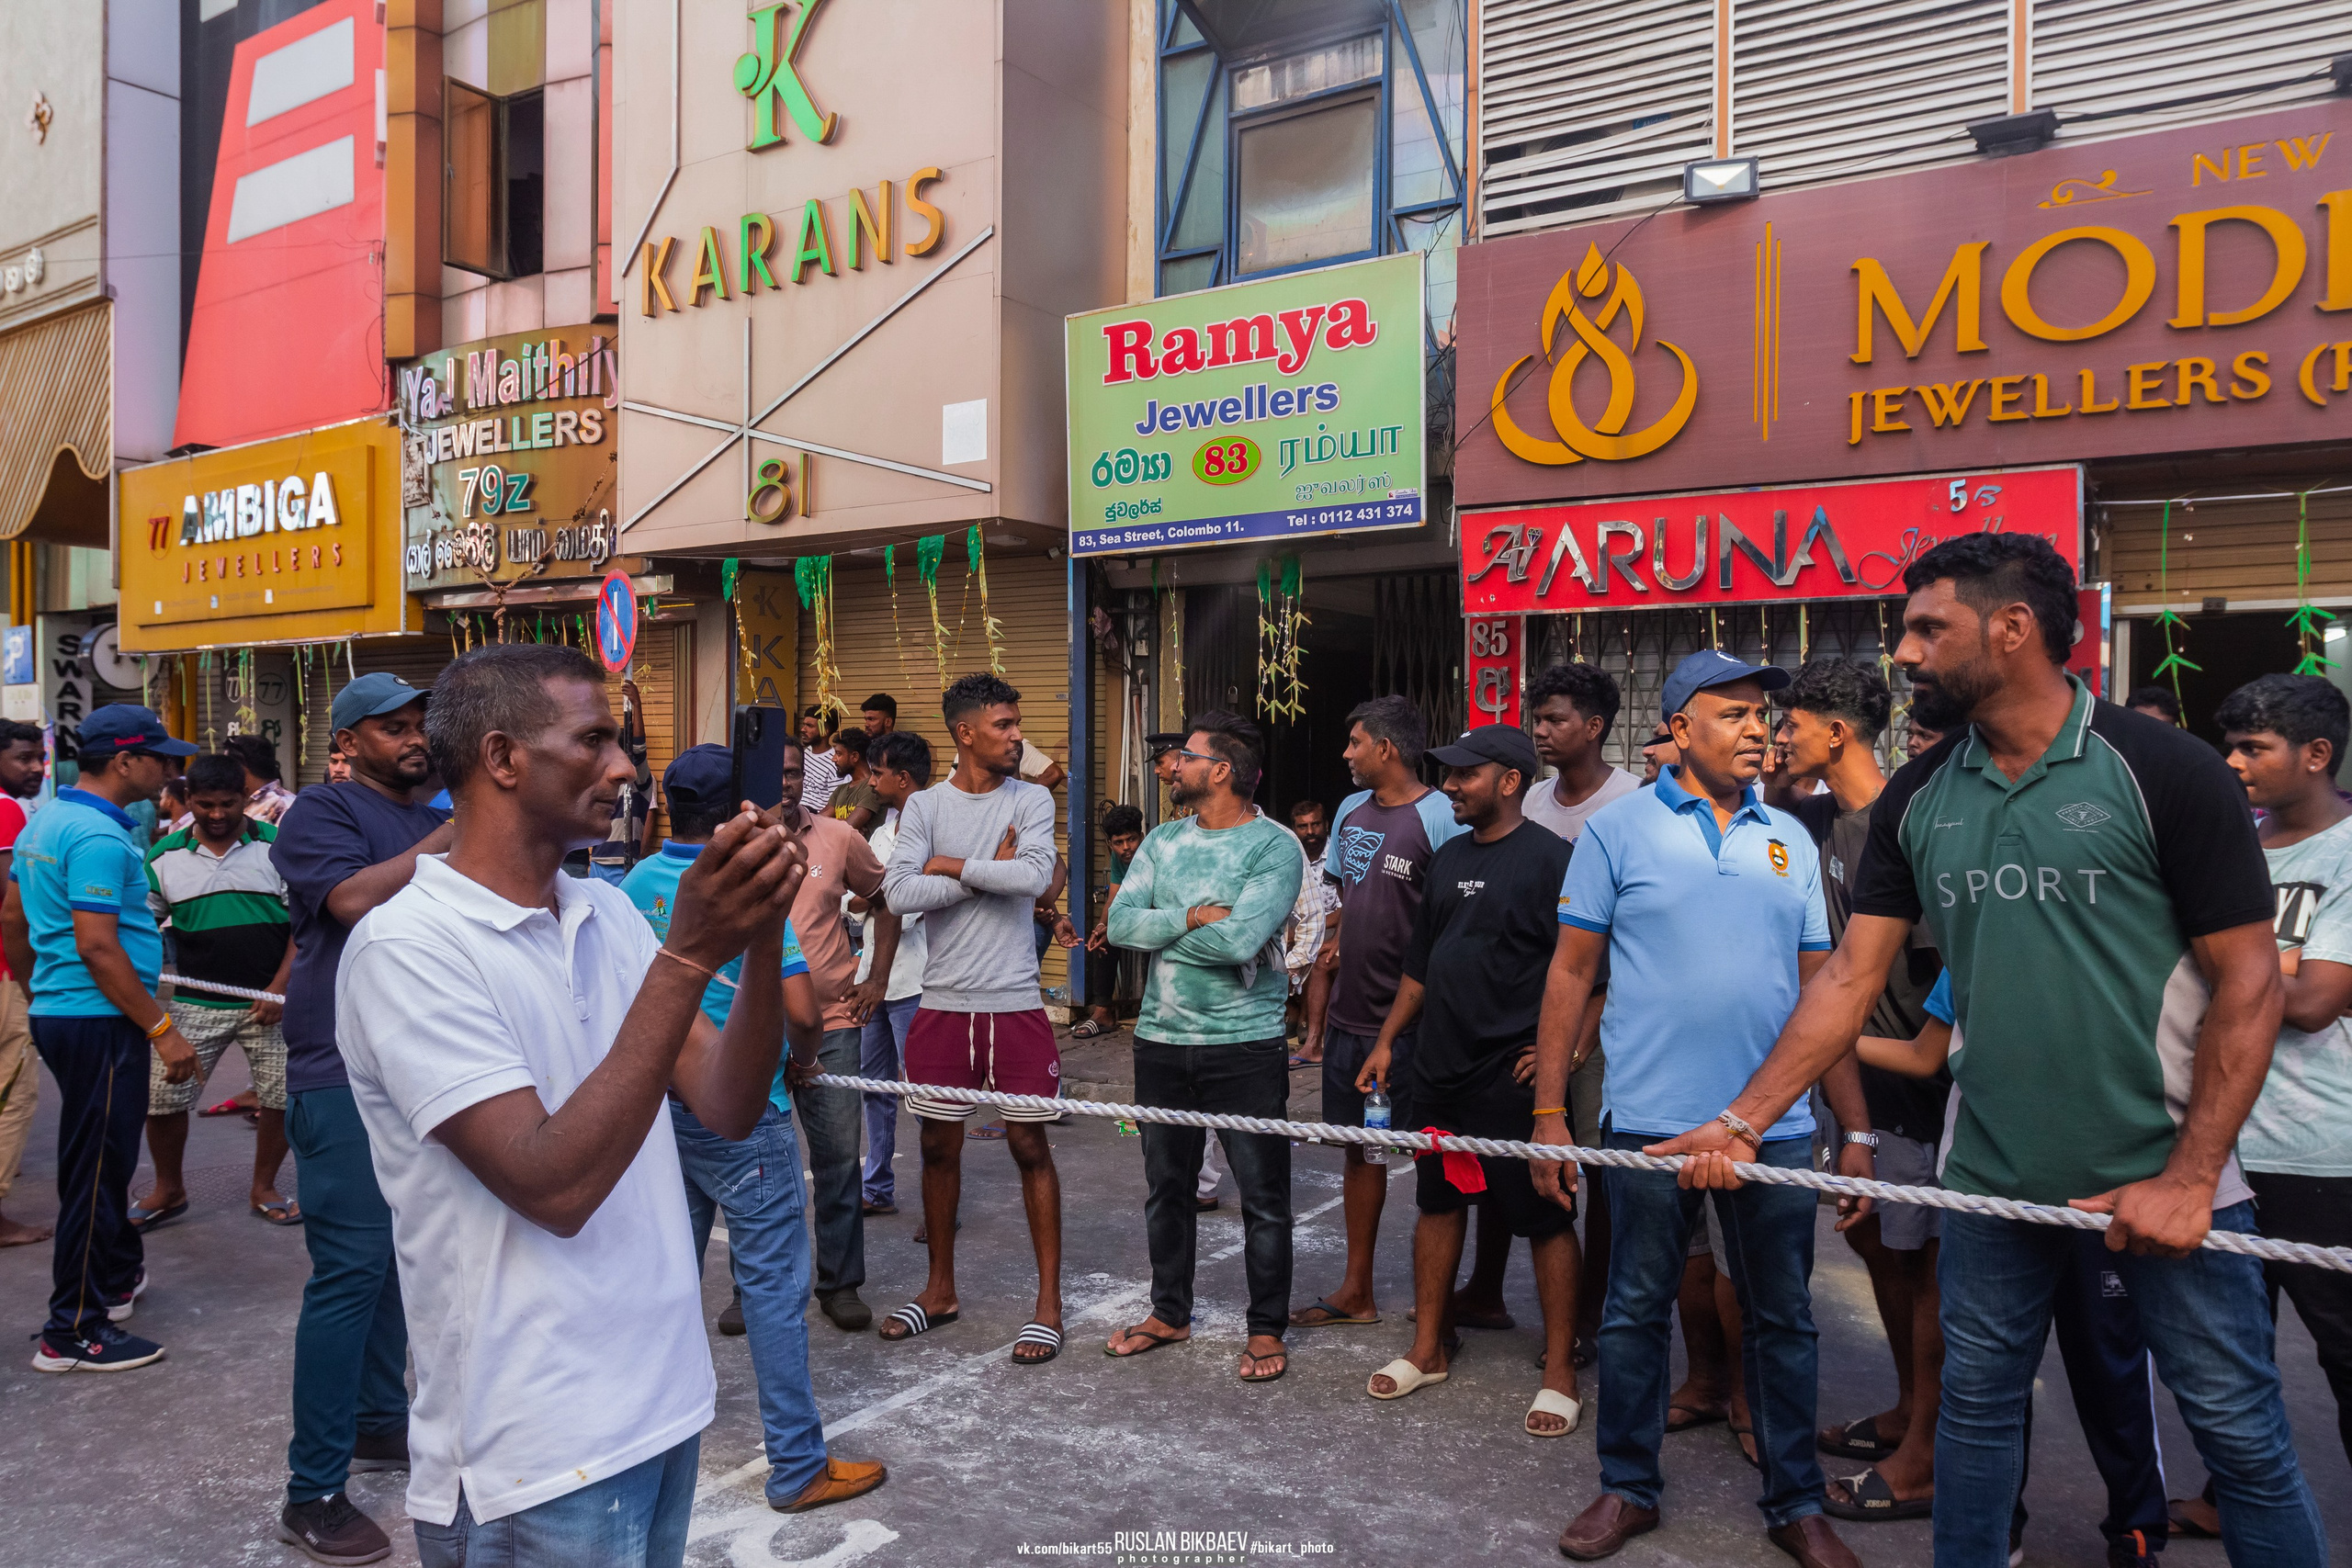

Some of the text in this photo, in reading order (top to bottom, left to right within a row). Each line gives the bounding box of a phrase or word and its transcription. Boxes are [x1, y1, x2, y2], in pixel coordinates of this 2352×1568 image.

[2191, 130, 2335, 187] NEW
[641, 167, 947, 318] KARANS
[1102, 299, 1378, 385] Ramya
[1136, 383, 1340, 435] Jewellers
[1848, 350, 2272, 446] JEWELLERS
[425, 408, 604, 465] JEWELLERS
[1280, 423, 1404, 479] ரம்யா
[1204, 442, 1249, 478] 83
[179, 471, 340, 546] AMBIGA
[746, 452, 811, 525] 81
[148, 515, 170, 551] 77
[1079, 520, 1244, 548] 83, Sea Street, Colombo 11.
[1287, 514, 1307, 527] Tel
[1319, 509, 1353, 525] 0112
[1356, 506, 1381, 520] 431
[1386, 503, 1413, 517] 374
[182, 543, 341, 583] JEWELLERS
[1534, 504, 1857, 596] ARUNA
[1471, 620, 1509, 658] 85
[258, 682, 283, 699] 77
[1384, 853, 1413, 875] STARK
[1937, 863, 2107, 908] SPORT
[1849, 1438, 1875, 1449] JORDAN
[1864, 1499, 1891, 1508] JORDAN
